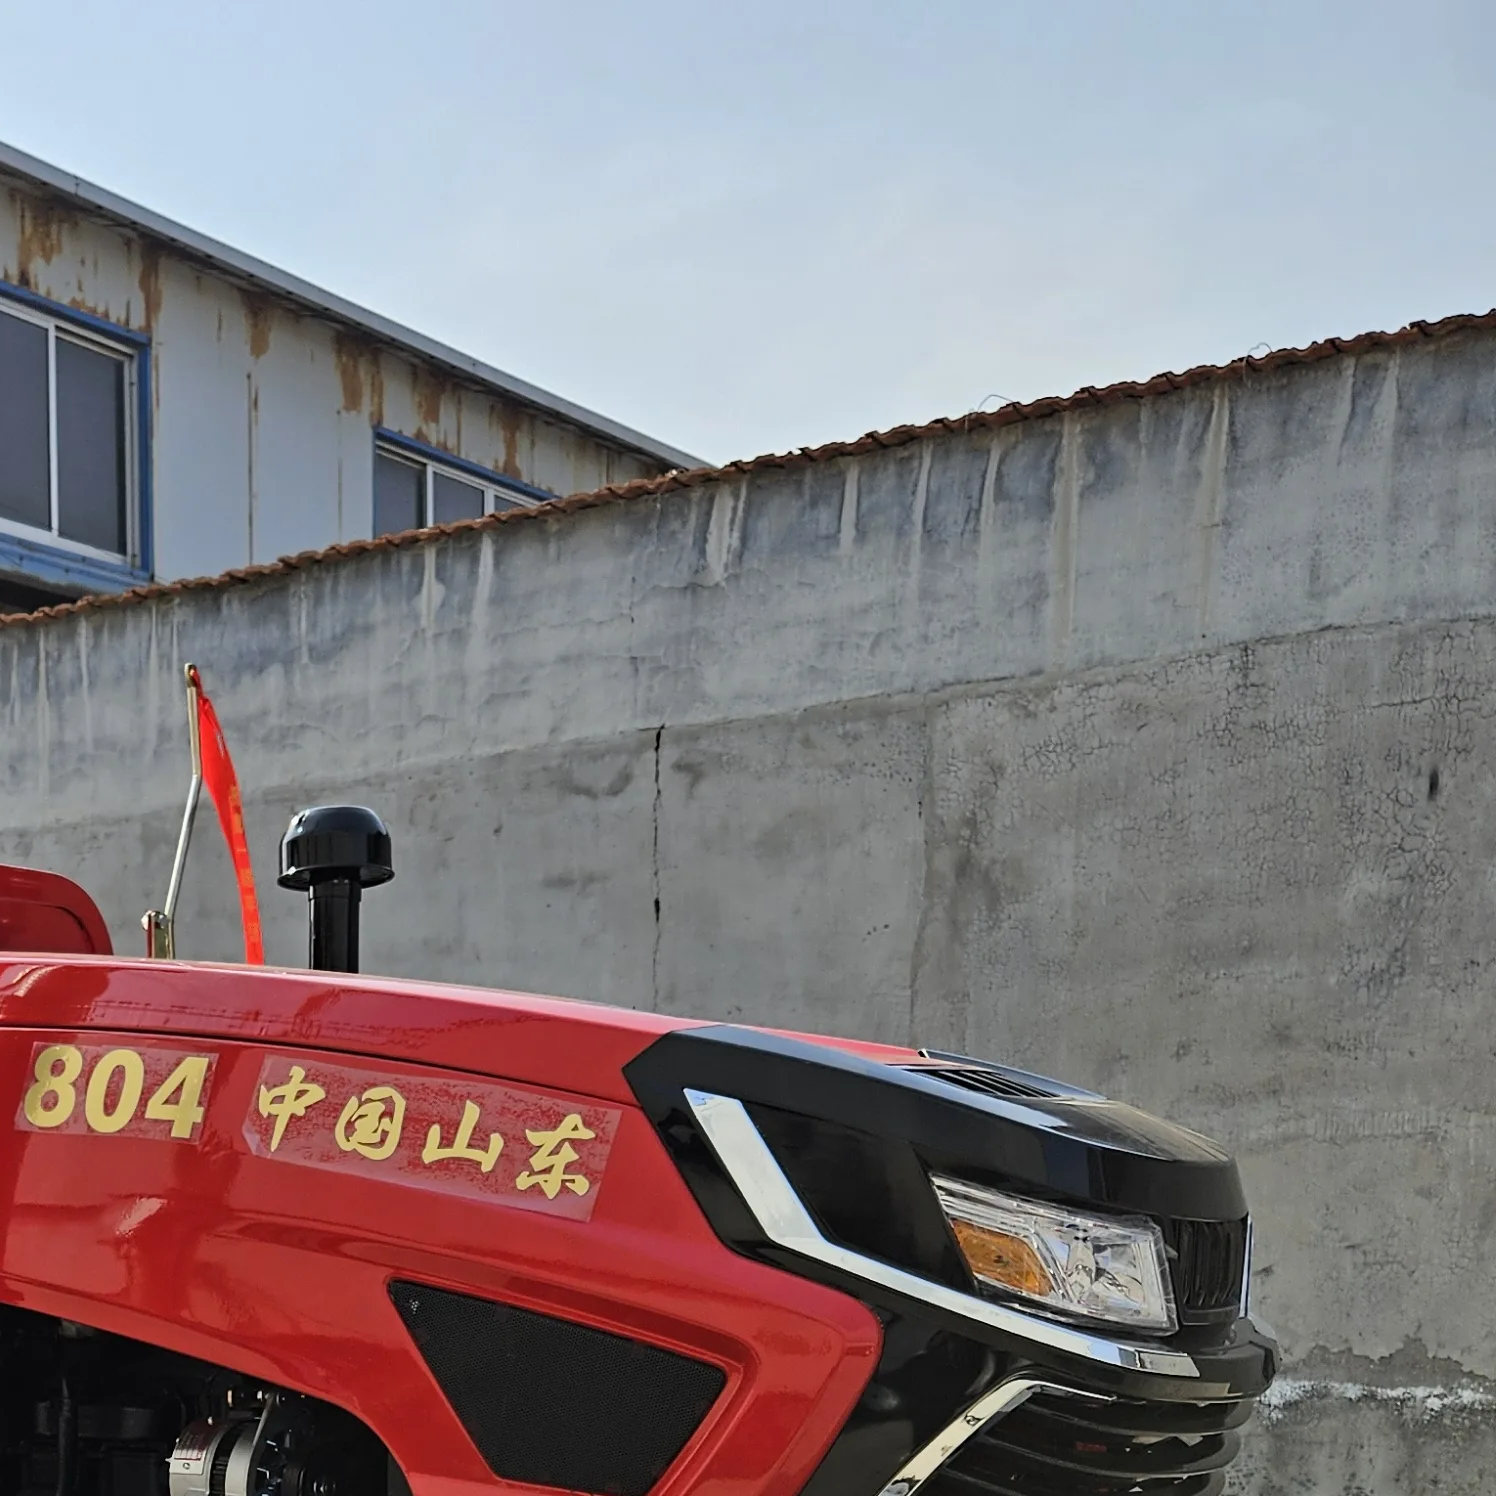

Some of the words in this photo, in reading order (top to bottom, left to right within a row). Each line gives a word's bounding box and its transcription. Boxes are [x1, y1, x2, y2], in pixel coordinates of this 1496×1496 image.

[23, 1044, 209, 1138] 804
[259, 1066, 594, 1200] 中国山东
